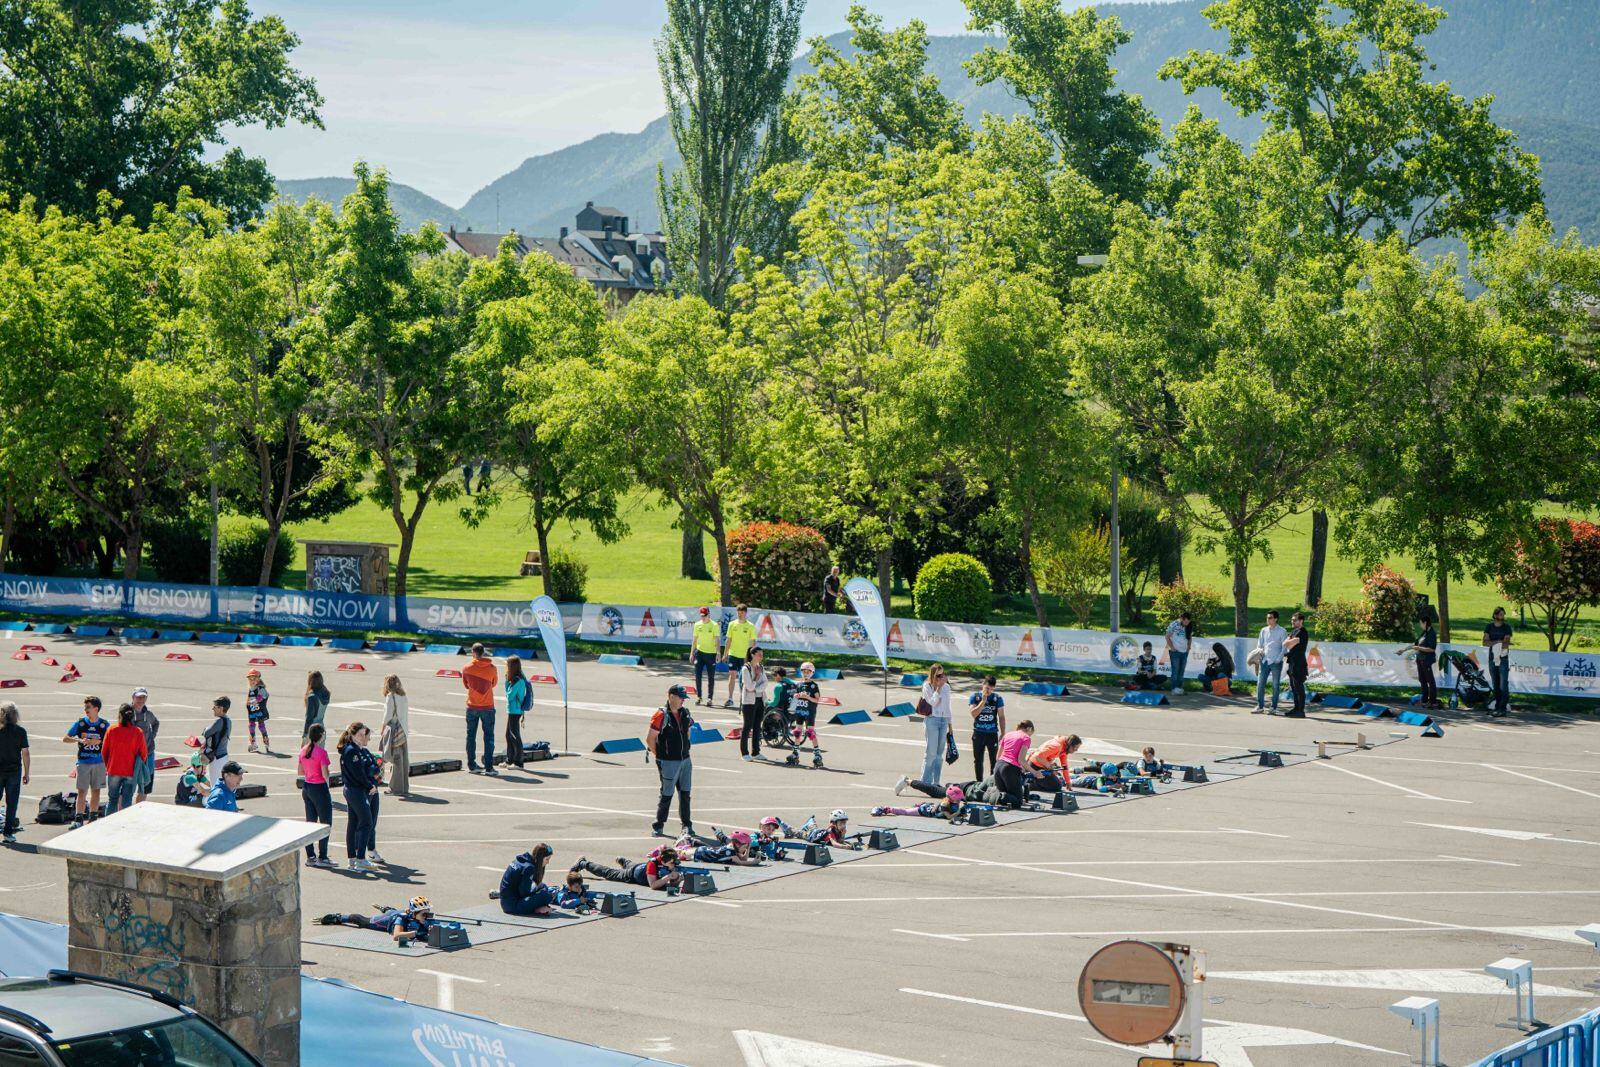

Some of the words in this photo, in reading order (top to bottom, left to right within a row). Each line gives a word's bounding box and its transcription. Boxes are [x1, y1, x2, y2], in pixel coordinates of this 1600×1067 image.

[91, 584, 209, 609] SPAINSNOW
[252, 594, 380, 619] SPAINSNOW
[427, 604, 535, 627] SPAINSNO
[787, 624, 824, 635] turismo
[917, 632, 956, 644] turismo
[1048, 641, 1090, 653] turismo
[1338, 655, 1385, 667] turismo
[1510, 662, 1543, 675] rismo
[979, 714, 994, 722] 229
